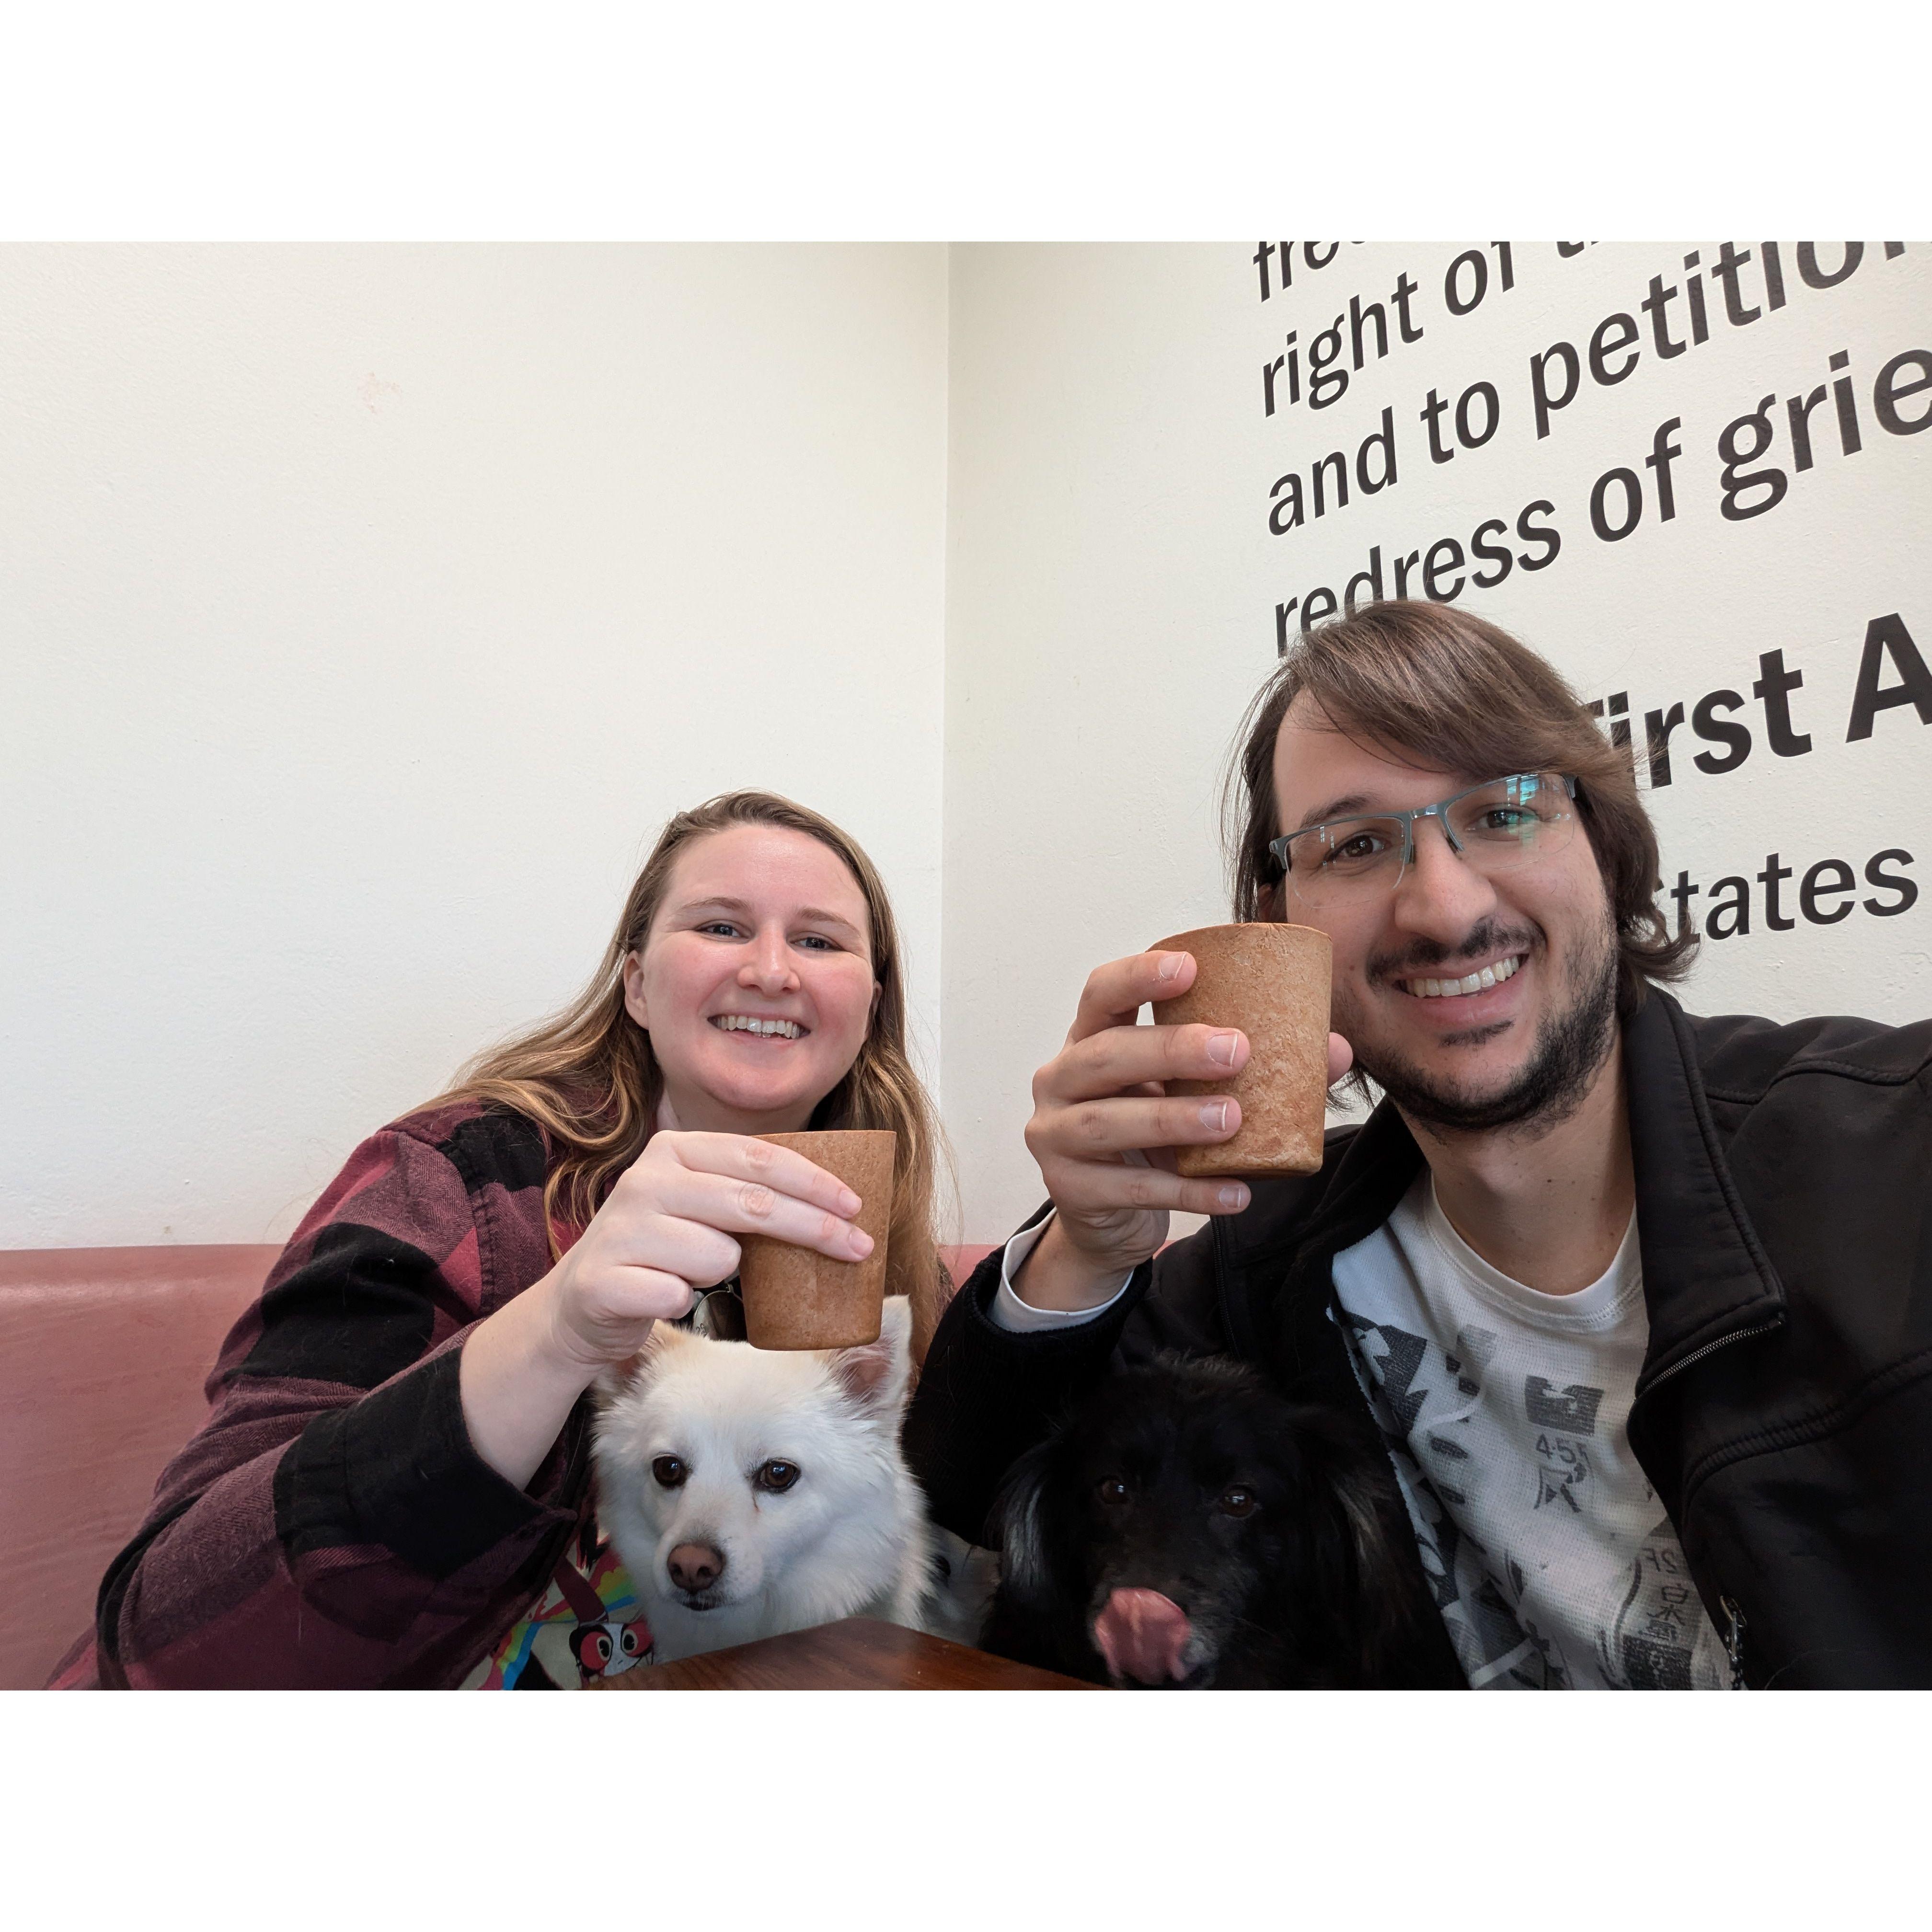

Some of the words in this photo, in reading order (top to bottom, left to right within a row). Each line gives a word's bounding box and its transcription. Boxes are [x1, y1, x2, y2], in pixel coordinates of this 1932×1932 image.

[1263, 271, 1424, 418] right
[1268, 405, 1397, 536] and
[1420, 381, 1500, 464] to
[1530, 242, 1906, 441] petitio
[1275, 499, 1561, 659] redress
[1590, 416, 1682, 542] of
[1718, 349, 1932, 522] grie
[1581, 648, 1813, 790] irst
[1845, 612, 1932, 743] A
[1655, 849, 1919, 943] tates
